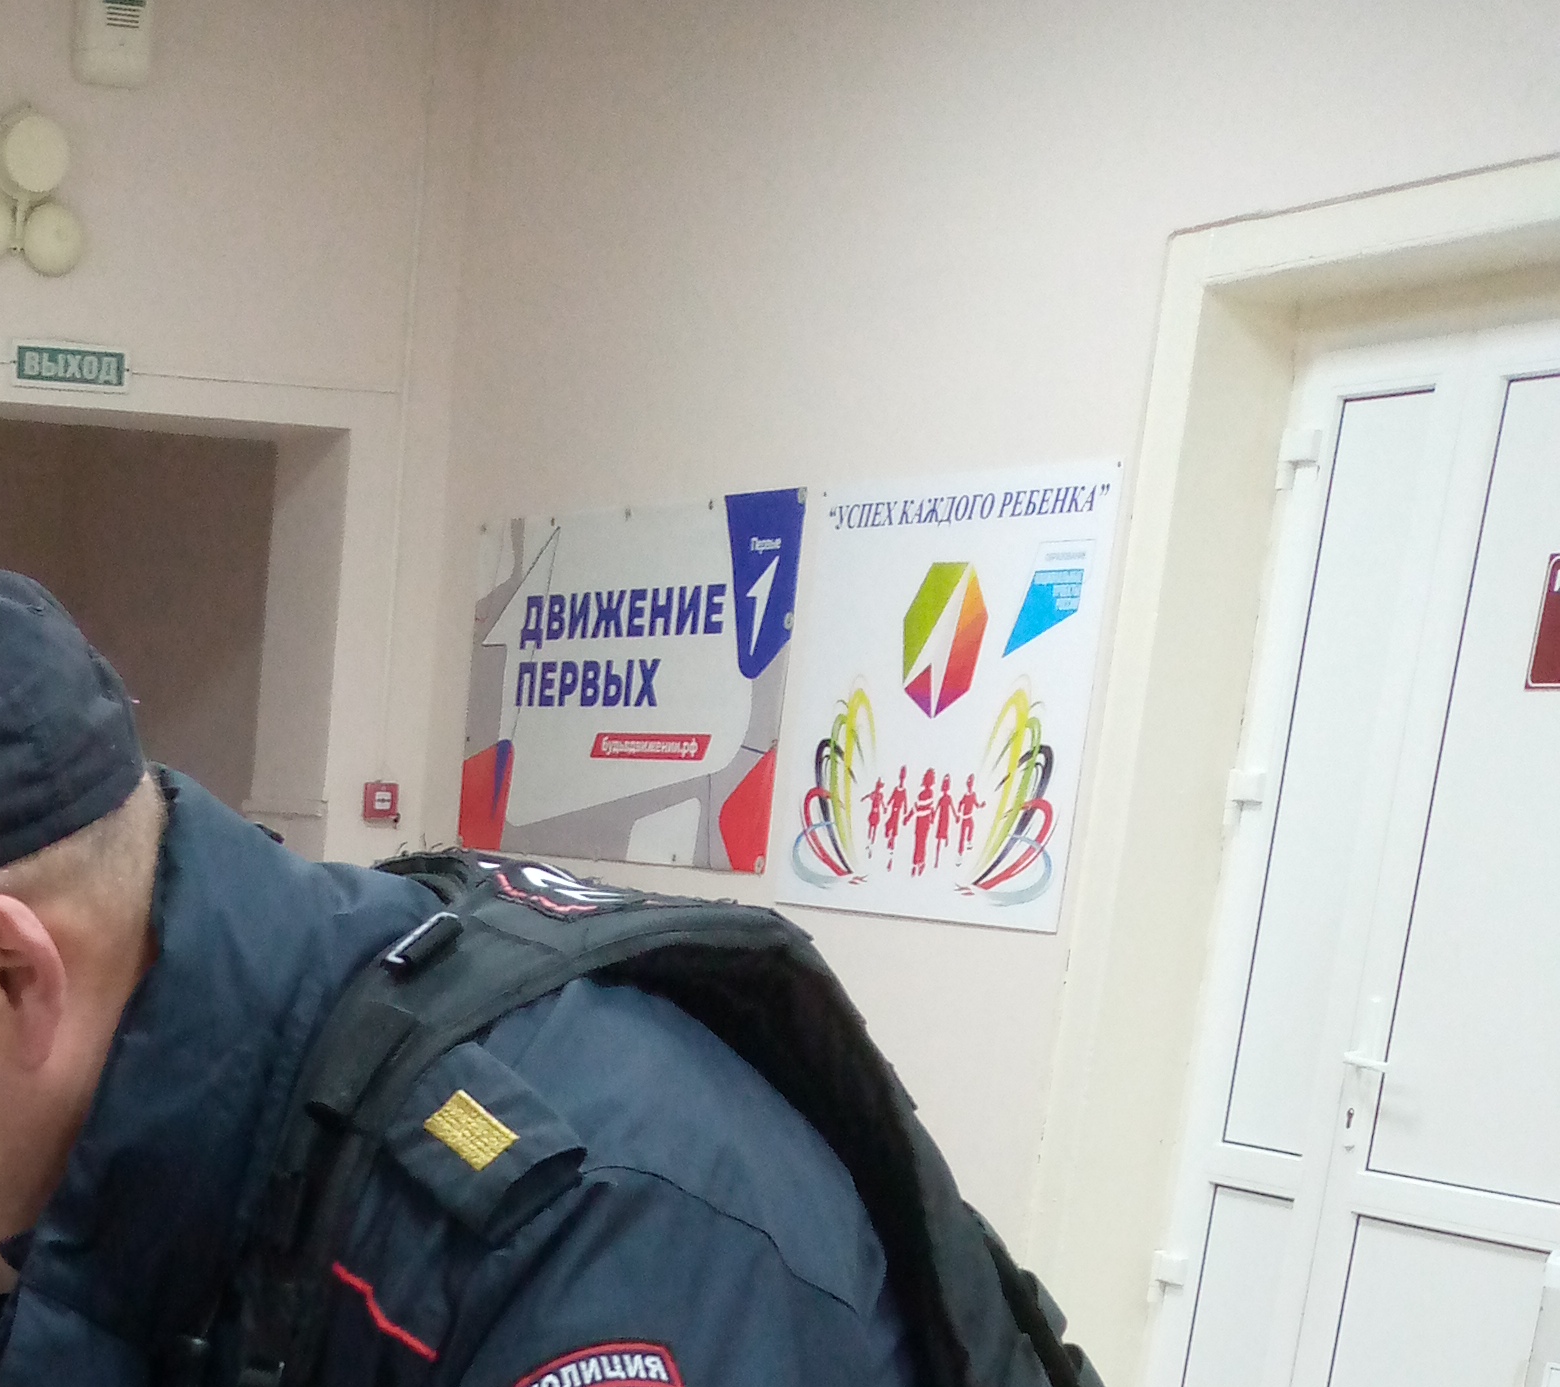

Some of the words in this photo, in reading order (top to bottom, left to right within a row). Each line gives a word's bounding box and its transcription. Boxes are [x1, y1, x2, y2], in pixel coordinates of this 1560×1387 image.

[23, 351, 118, 384] ВЫХОД
[897, 493, 996, 527] КАЖДОГО
[519, 583, 728, 650] ДВИЖЕНИЕ
[515, 658, 662, 708] ПЕРВЫХ
